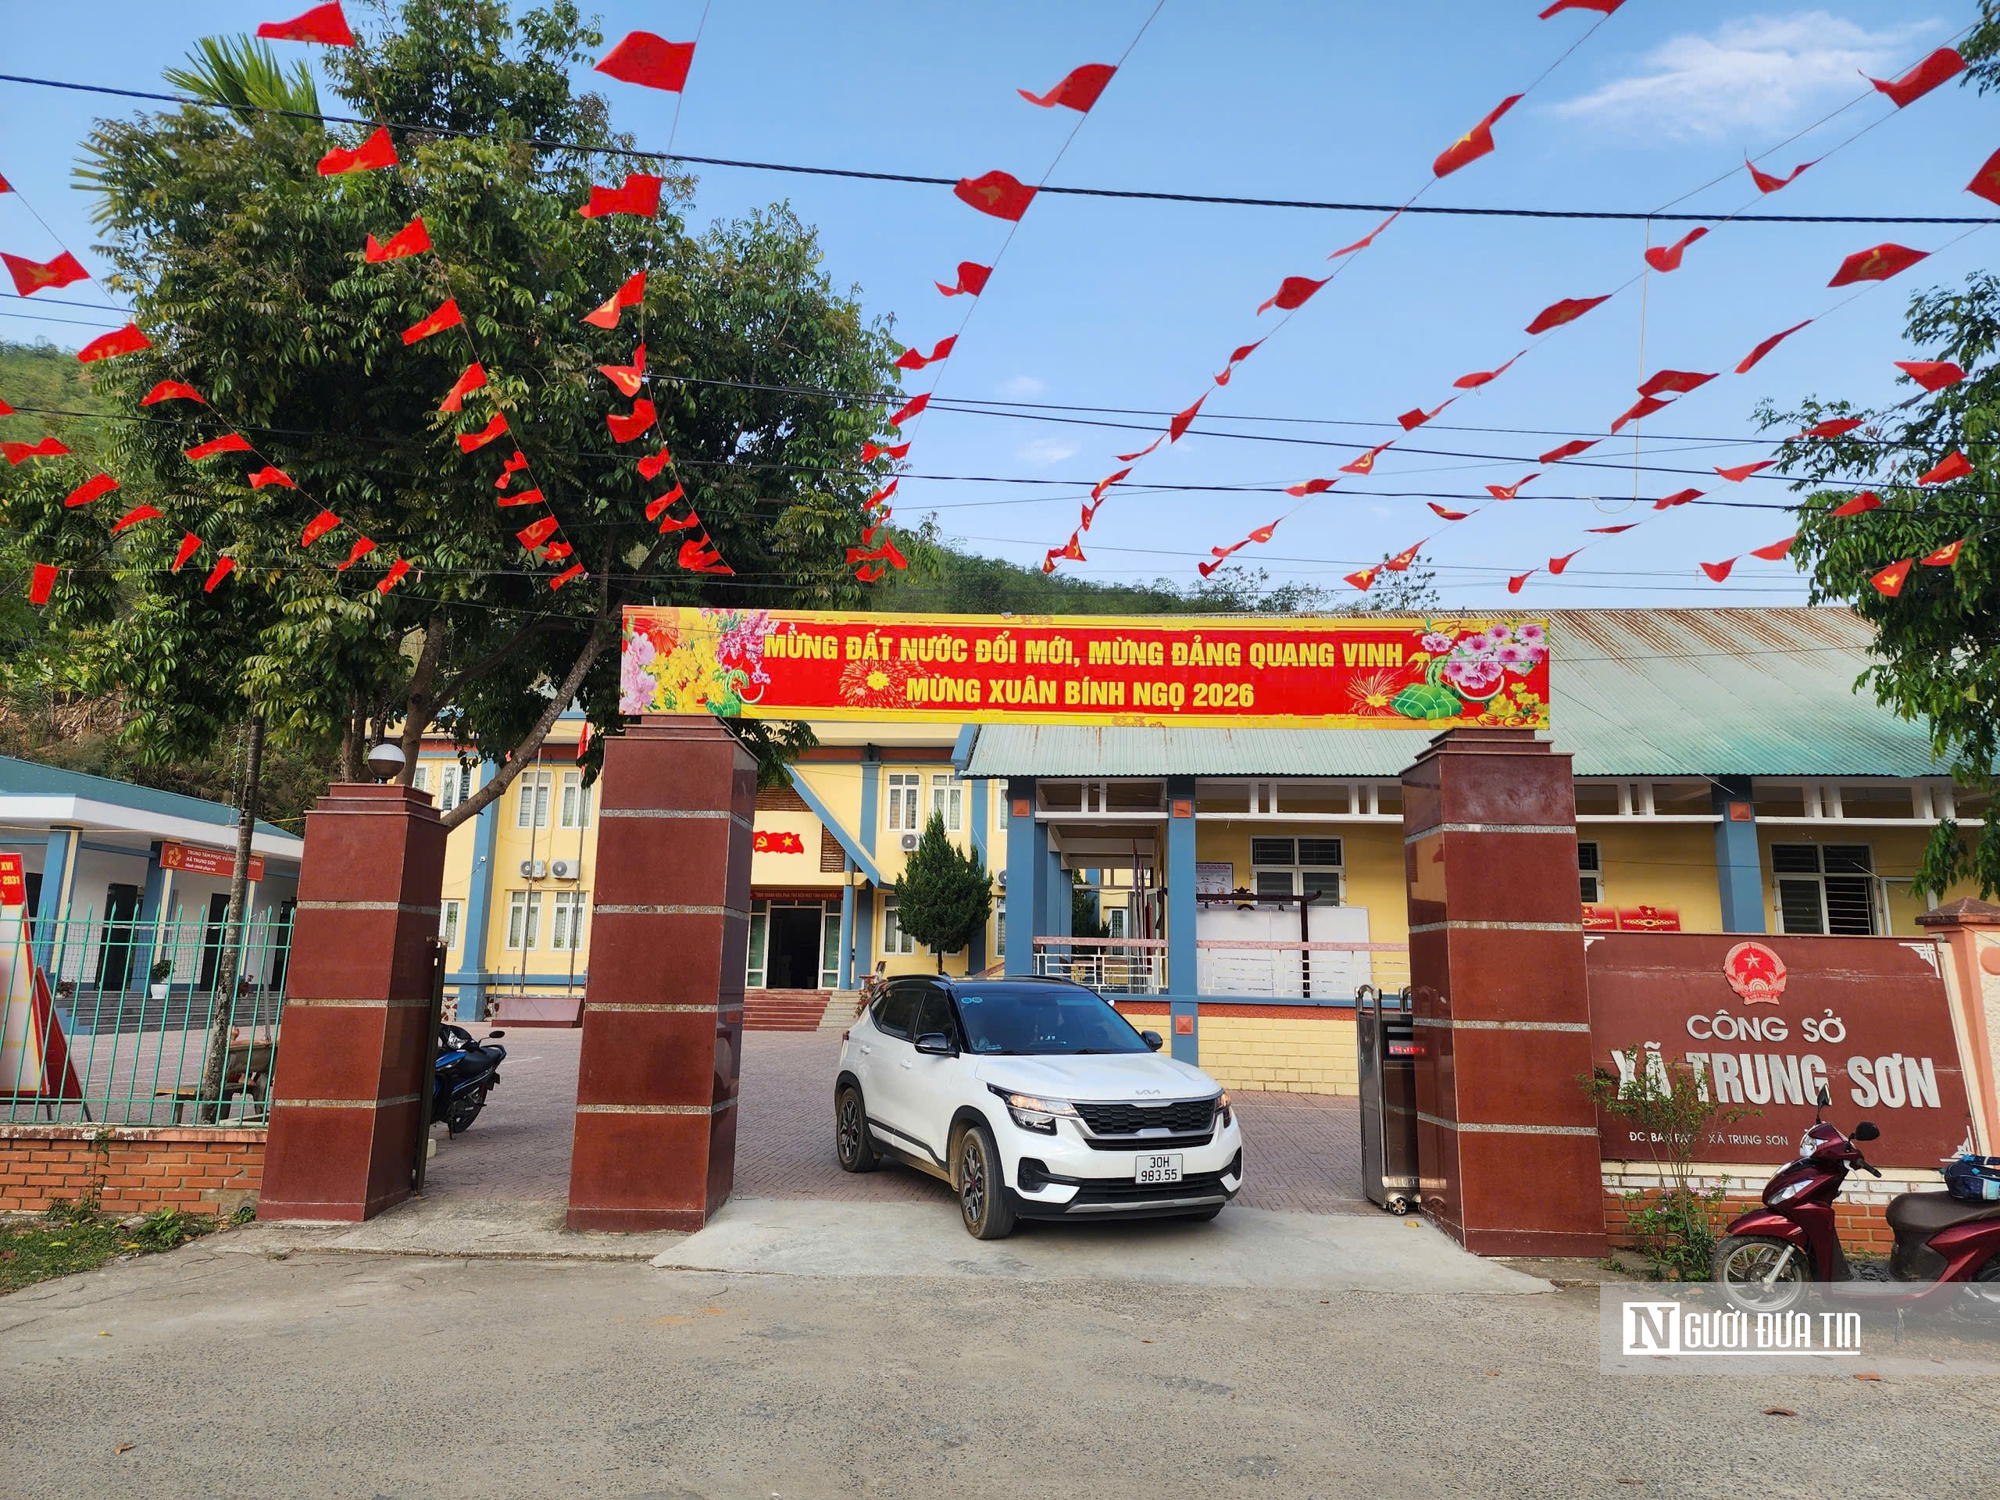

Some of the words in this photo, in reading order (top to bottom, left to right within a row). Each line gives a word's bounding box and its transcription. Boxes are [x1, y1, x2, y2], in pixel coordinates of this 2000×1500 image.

[763, 630, 838, 660] MỪNG
[846, 629, 893, 661] ĐẤT
[901, 634, 968, 662] NƯỚC
[975, 631, 1017, 664] ĐỔI
[1025, 636, 1080, 668] MỚI,
[1089, 637, 1164, 666] MỪNG
[1171, 635, 1241, 667] ĐẢNG
[1250, 643, 1335, 669] QUANG
[1342, 643, 1403, 668] VINH
[906, 673, 981, 703] MỪNG
[989, 675, 1057, 704] XUÂN
[1065, 676, 1125, 706] BÍNH
[1133, 682, 1185, 712] NGỌ
[1192, 683, 1255, 707] 2026
[1686, 1008, 1789, 1042] CÔNG
[1801, 1008, 1847, 1044] SỞ
[1611, 1041, 1672, 1101] XÃ
[1685, 1051, 1833, 1106] TRUNG
[1847, 1053, 1942, 1109] SƠN
[1708, 1132, 1725, 1144] XÃ
[1728, 1134, 1762, 1145] TRUNG
[1765, 1134, 1789, 1146] SƠN
[1141, 1169, 1178, 1182] 983.55
[1149, 1156, 1170, 1169] 30H
